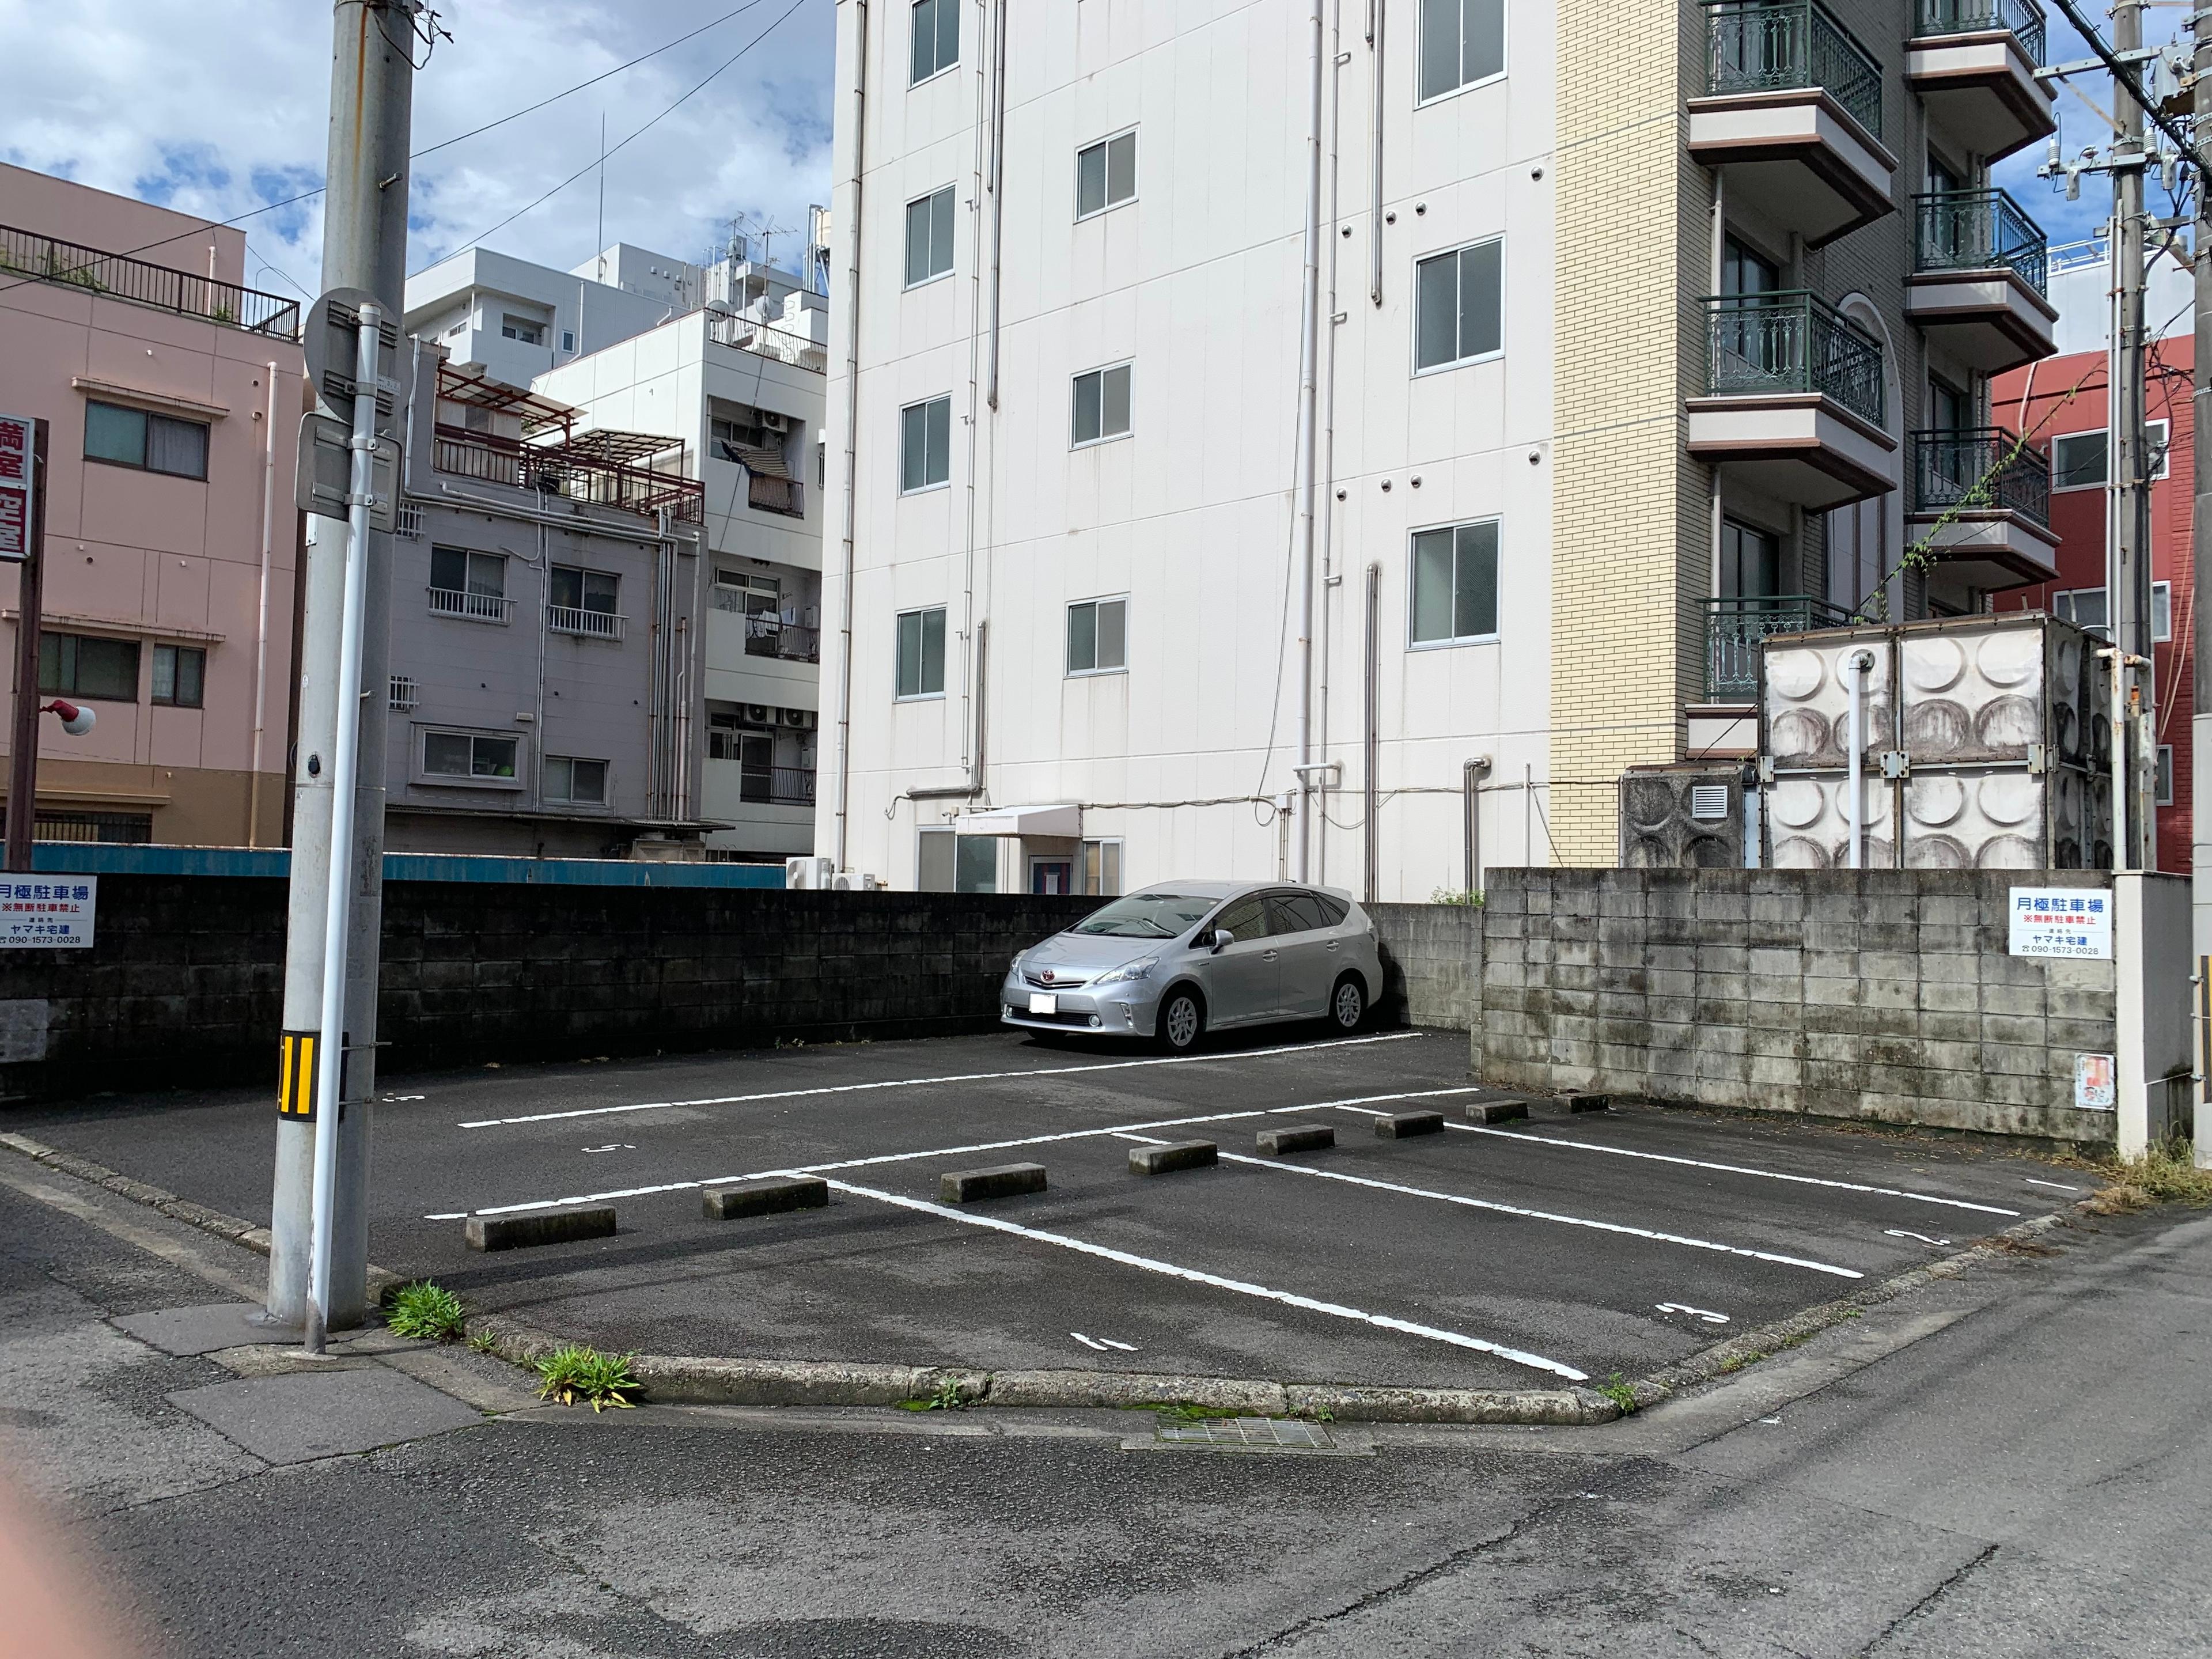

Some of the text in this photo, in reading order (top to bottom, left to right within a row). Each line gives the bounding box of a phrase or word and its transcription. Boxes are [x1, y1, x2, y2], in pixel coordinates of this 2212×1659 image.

[0, 884, 89, 900] 月極駐車場
[2017, 897, 2104, 912] 月極駐車場
[11, 925, 70, 934] ヤマキ宅建
[2033, 935, 2088, 946] ヤマキ宅建
[2031, 945, 2099, 955] 090-1573-0028
